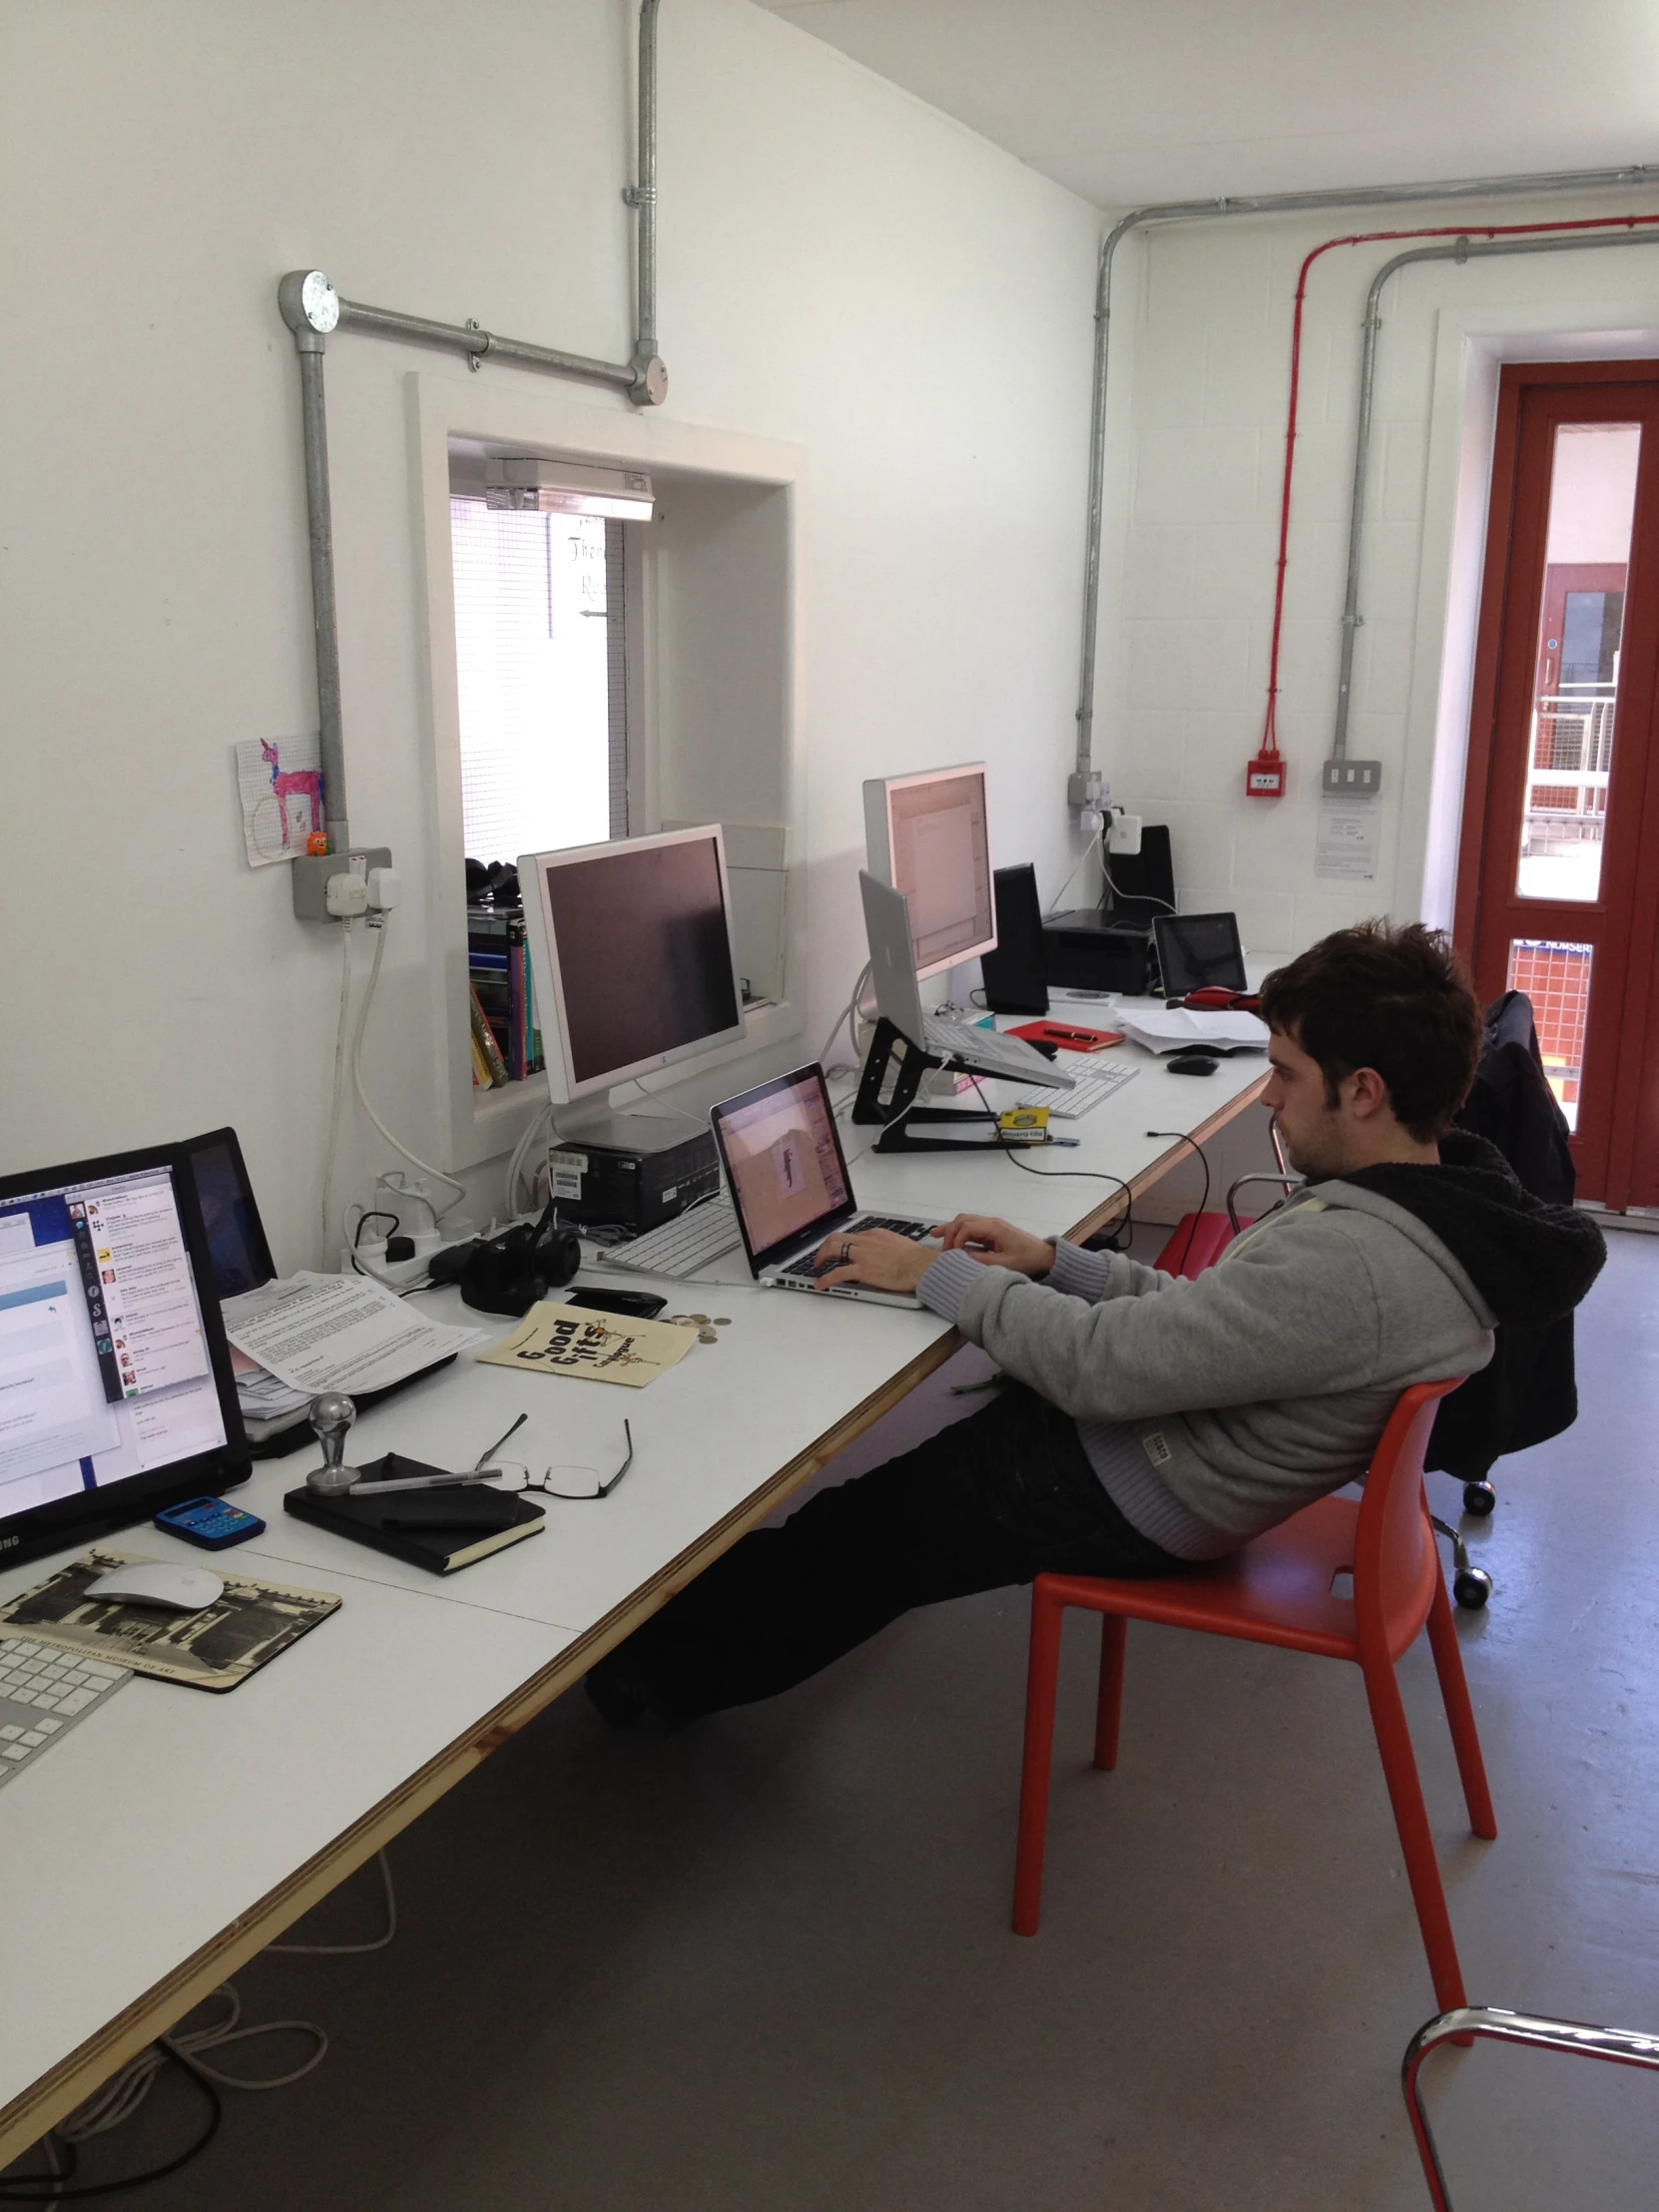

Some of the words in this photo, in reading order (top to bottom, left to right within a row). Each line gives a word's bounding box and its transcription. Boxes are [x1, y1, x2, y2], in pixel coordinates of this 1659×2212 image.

[1545, 941, 1594, 953] NURSER
[517, 1319, 580, 1360] Good
[550, 1326, 605, 1366] Gifts
[41, 1639, 102, 1658] METROPOLITAN
[106, 1654, 142, 1667] MUSEUM
